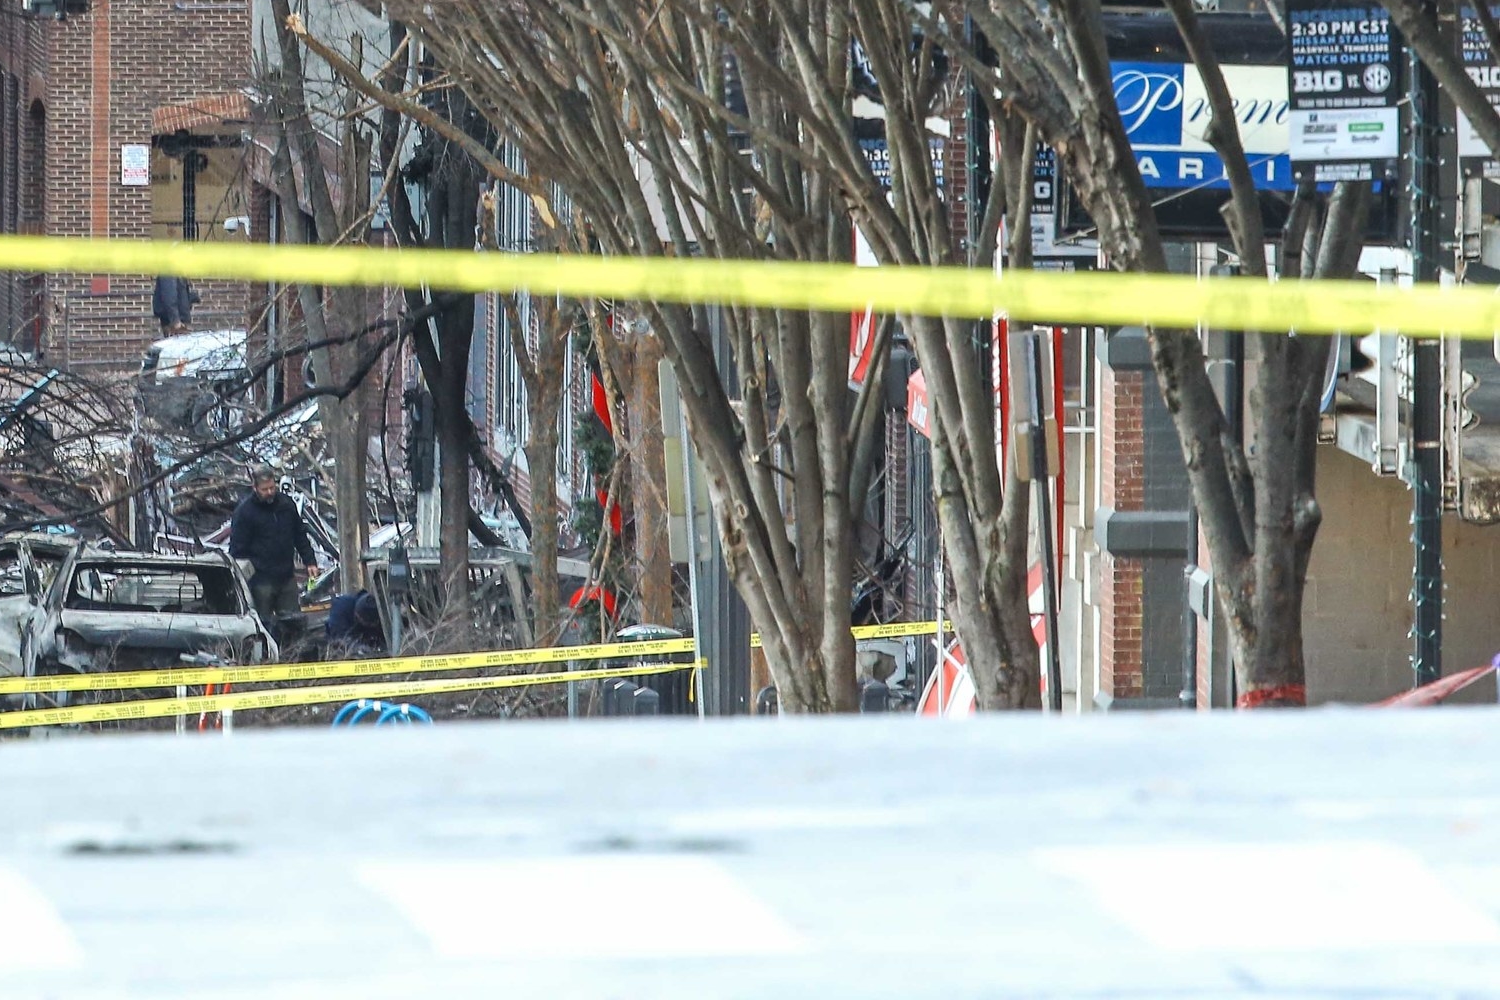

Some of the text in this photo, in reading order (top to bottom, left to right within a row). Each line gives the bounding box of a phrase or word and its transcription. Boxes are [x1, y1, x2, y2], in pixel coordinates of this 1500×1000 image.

[1292, 20, 1389, 36] 2:30 PM CST
[1292, 34, 1389, 46] NISSAN STADIUM
[1293, 53, 1390, 66] WATCH ON ESPN
[1364, 65, 1390, 92] SEC
